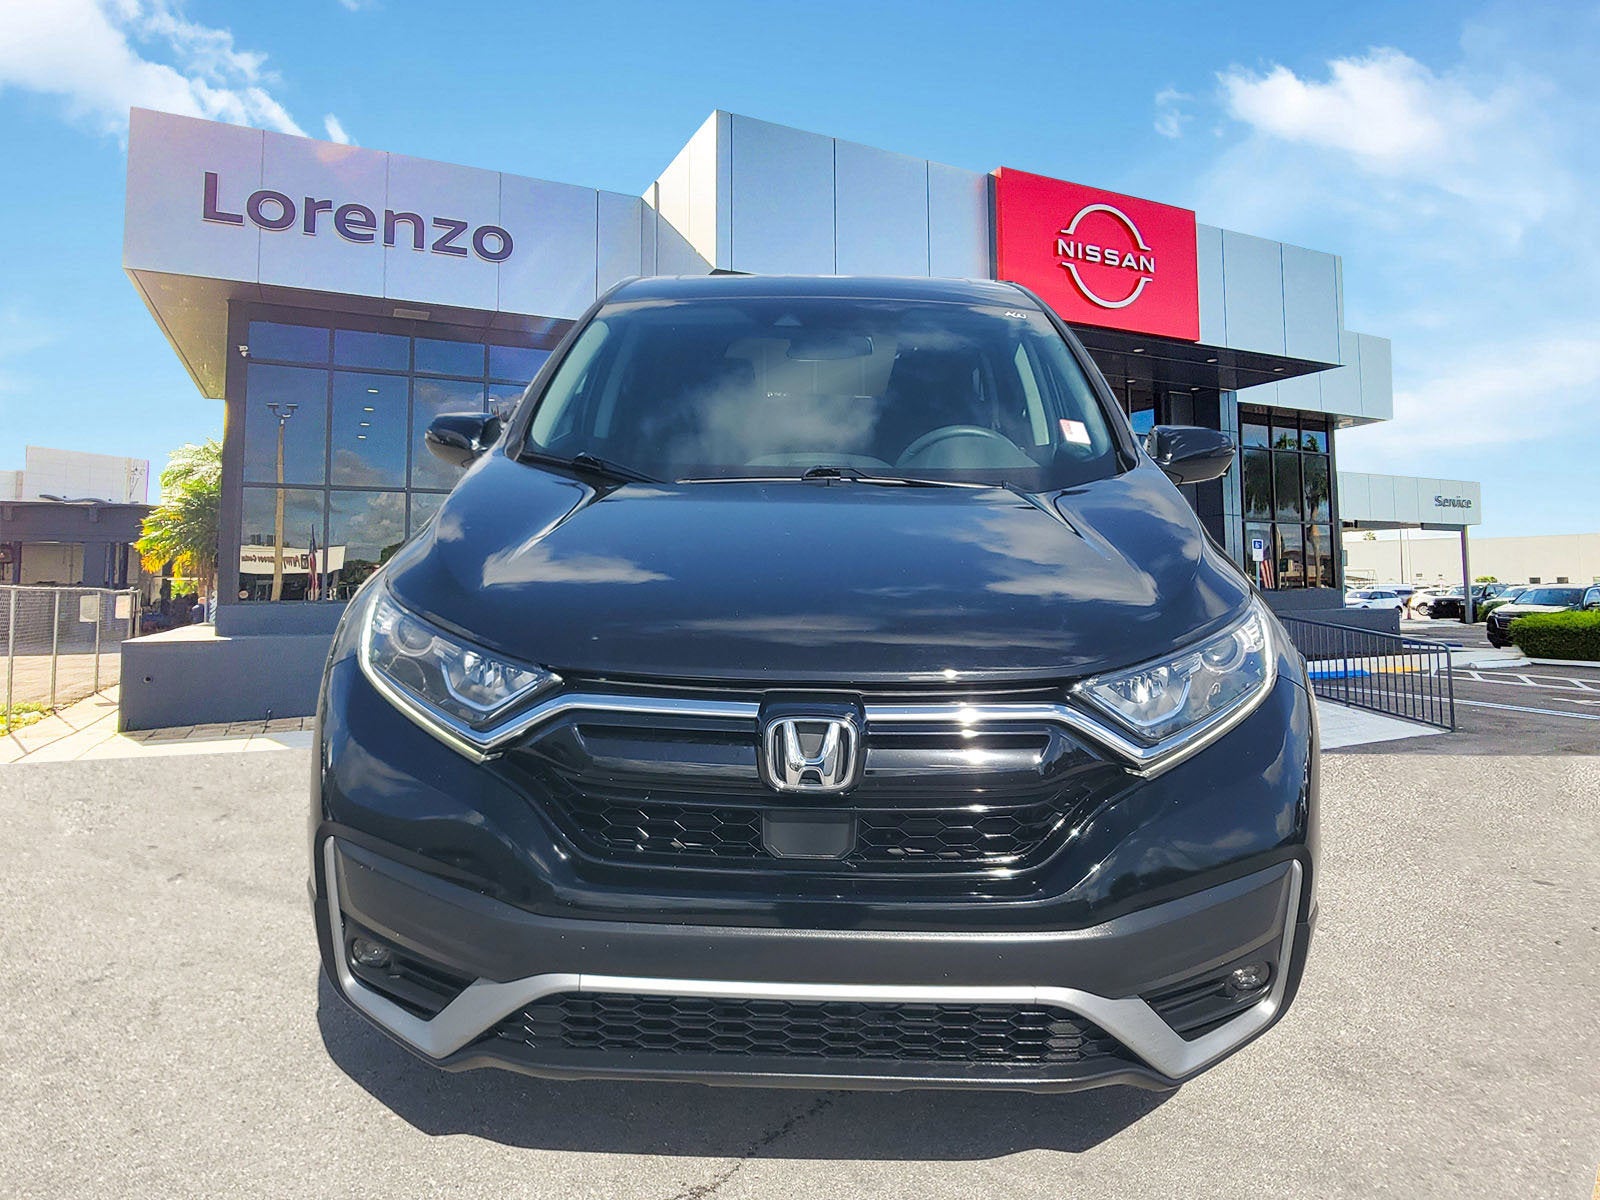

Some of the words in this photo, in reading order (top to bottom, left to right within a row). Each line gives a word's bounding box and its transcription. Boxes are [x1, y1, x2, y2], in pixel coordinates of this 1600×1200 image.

[202, 171, 514, 262] Lorenzo
[1057, 238, 1155, 273] NISSAN
[1434, 495, 1472, 508] Service
